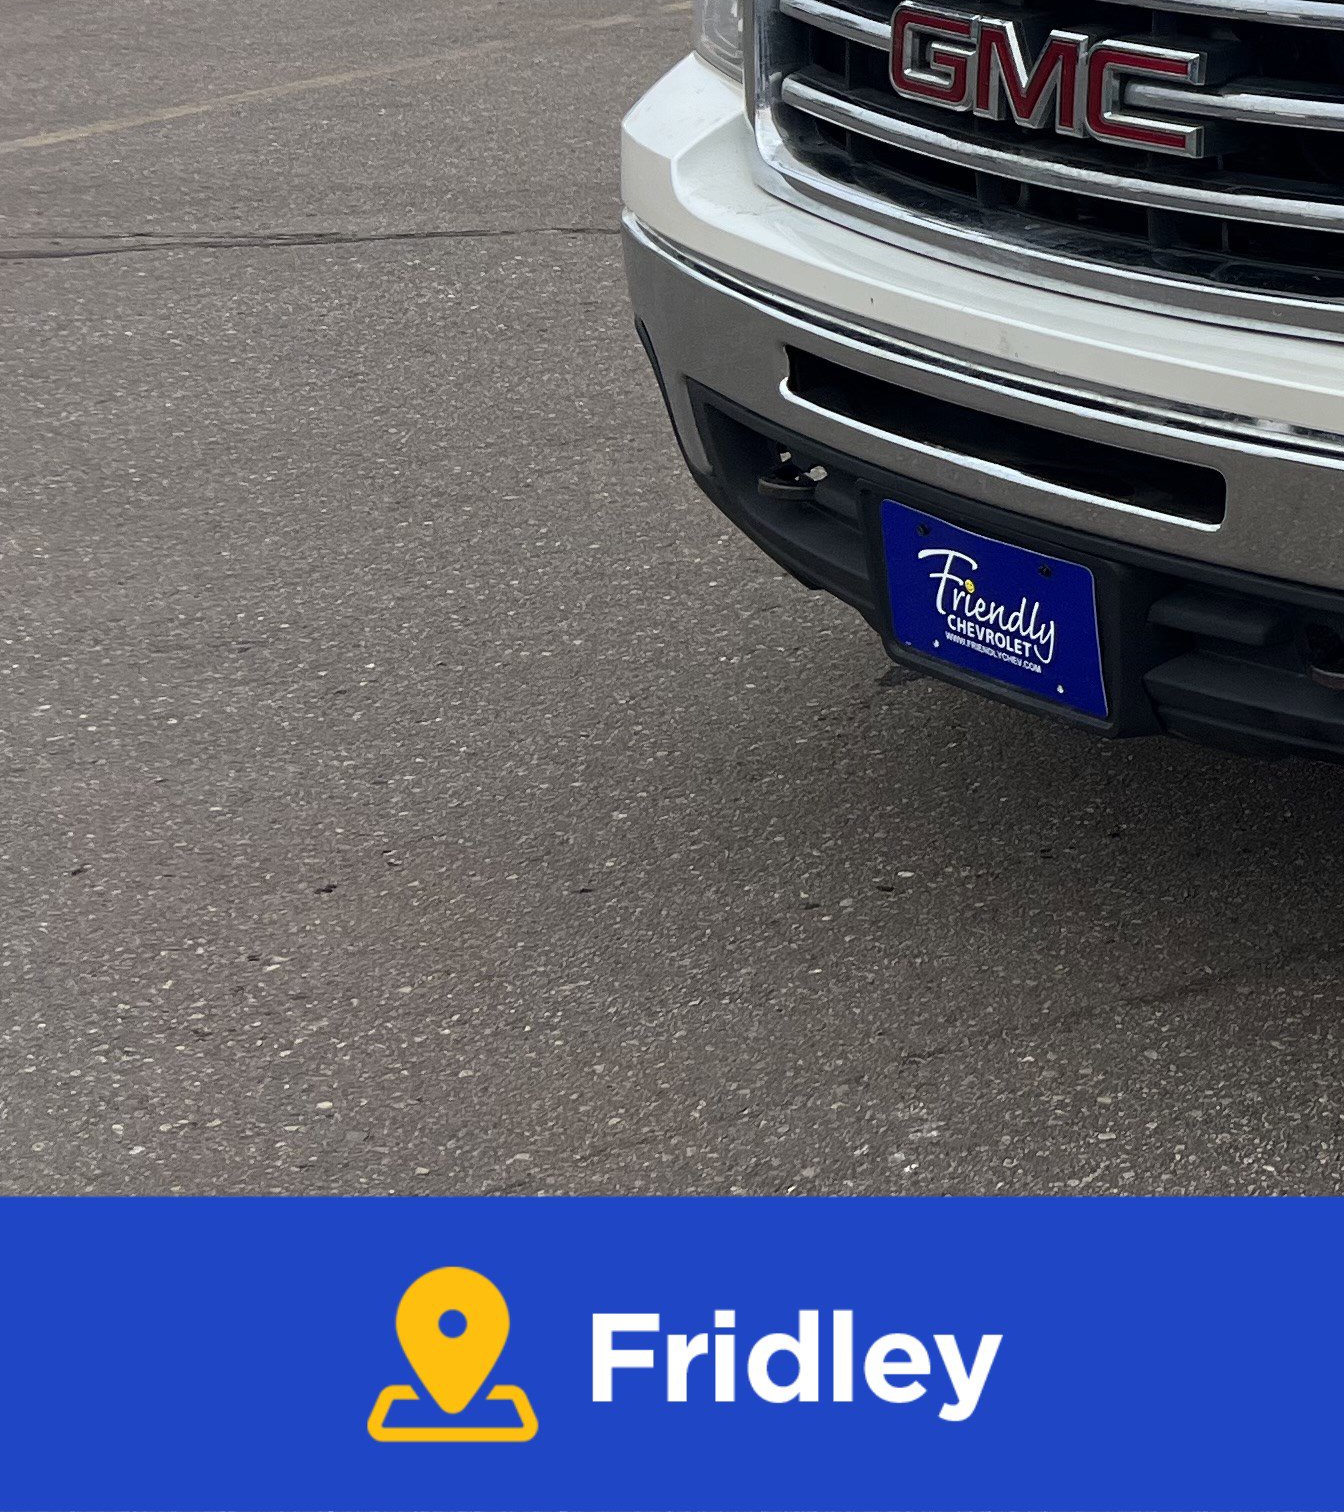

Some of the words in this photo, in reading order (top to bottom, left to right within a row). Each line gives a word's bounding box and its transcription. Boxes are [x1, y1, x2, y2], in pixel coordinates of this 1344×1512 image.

[889, 0, 1208, 159] GMC
[917, 548, 1056, 664] Friendly
[946, 614, 1032, 658] CHEVROLET
[944, 630, 1043, 674] WWW.FRIENDLYCHEV.COM
